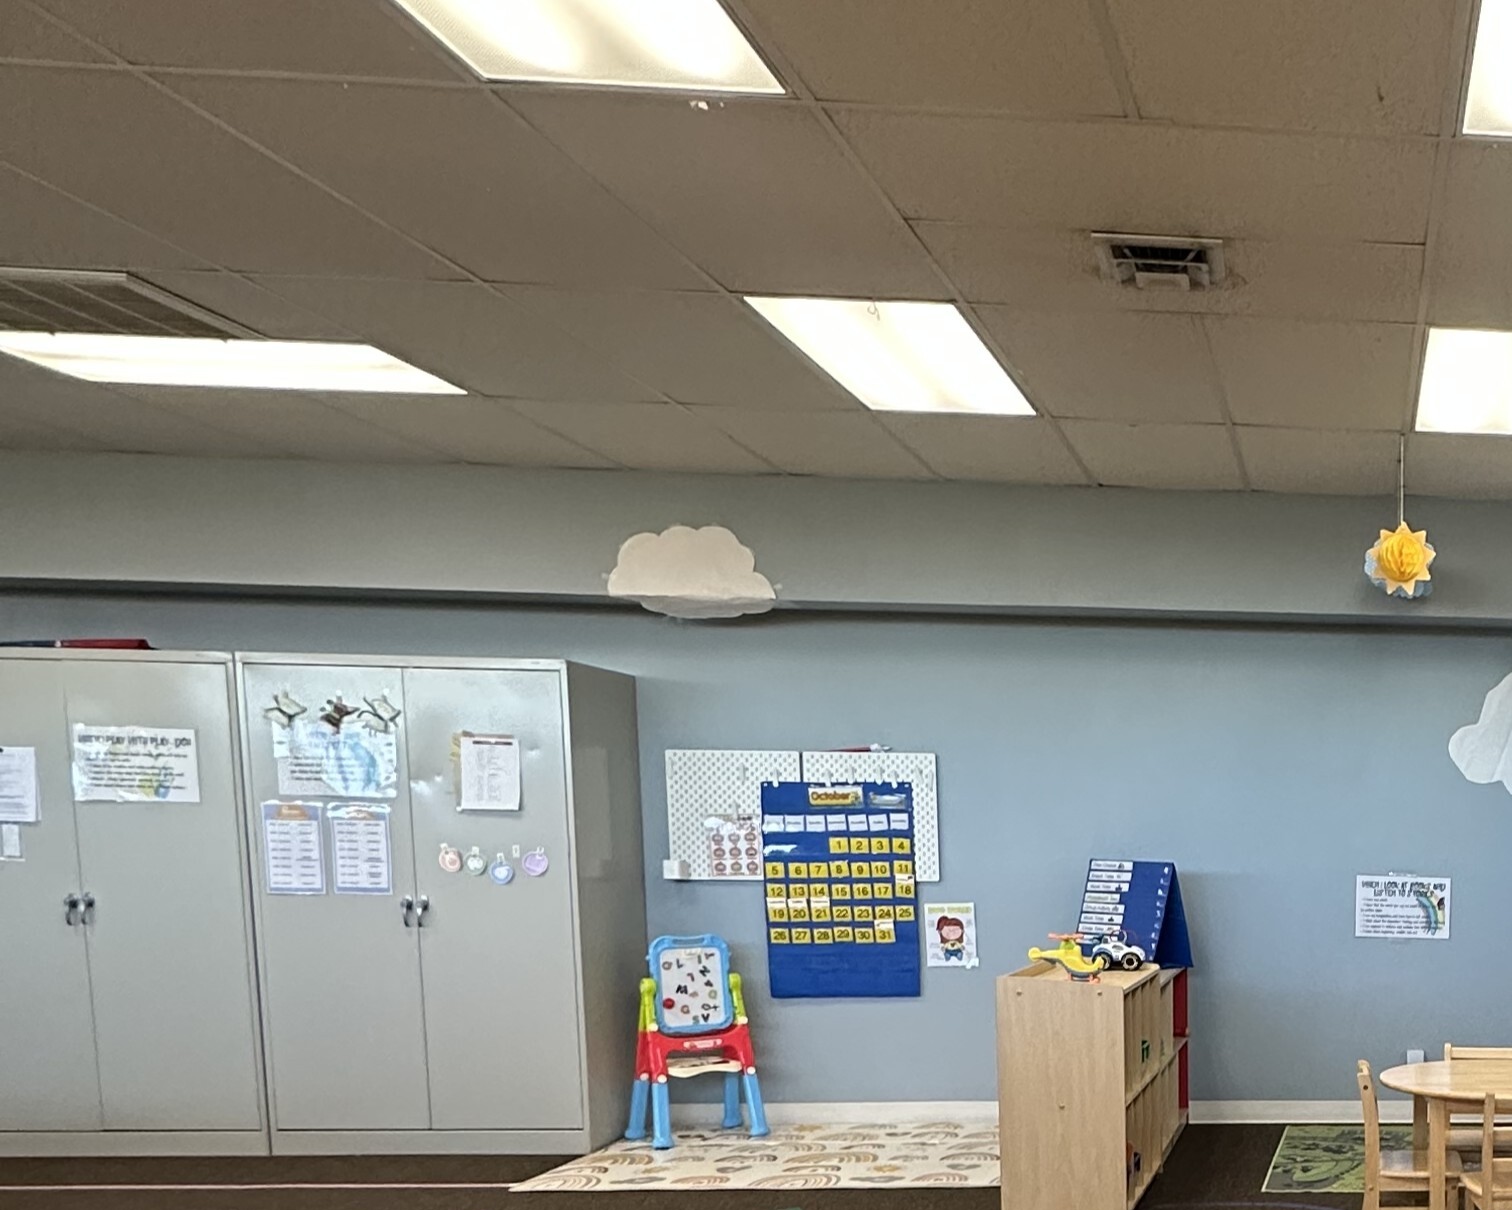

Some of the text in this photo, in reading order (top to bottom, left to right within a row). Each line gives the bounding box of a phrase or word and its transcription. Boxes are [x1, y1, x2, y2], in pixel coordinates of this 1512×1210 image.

[811, 791, 851, 801] October
[837, 841, 905, 850] 1 2 3 4
[772, 864, 909, 876] 5 6 7 8 9 10 11
[771, 886, 912, 897] 12 13 14 15 16 17 18
[772, 908, 912, 919] 19 20 21 22 23 24 25
[773, 929, 892, 940] 26 27 28 29 30 31
